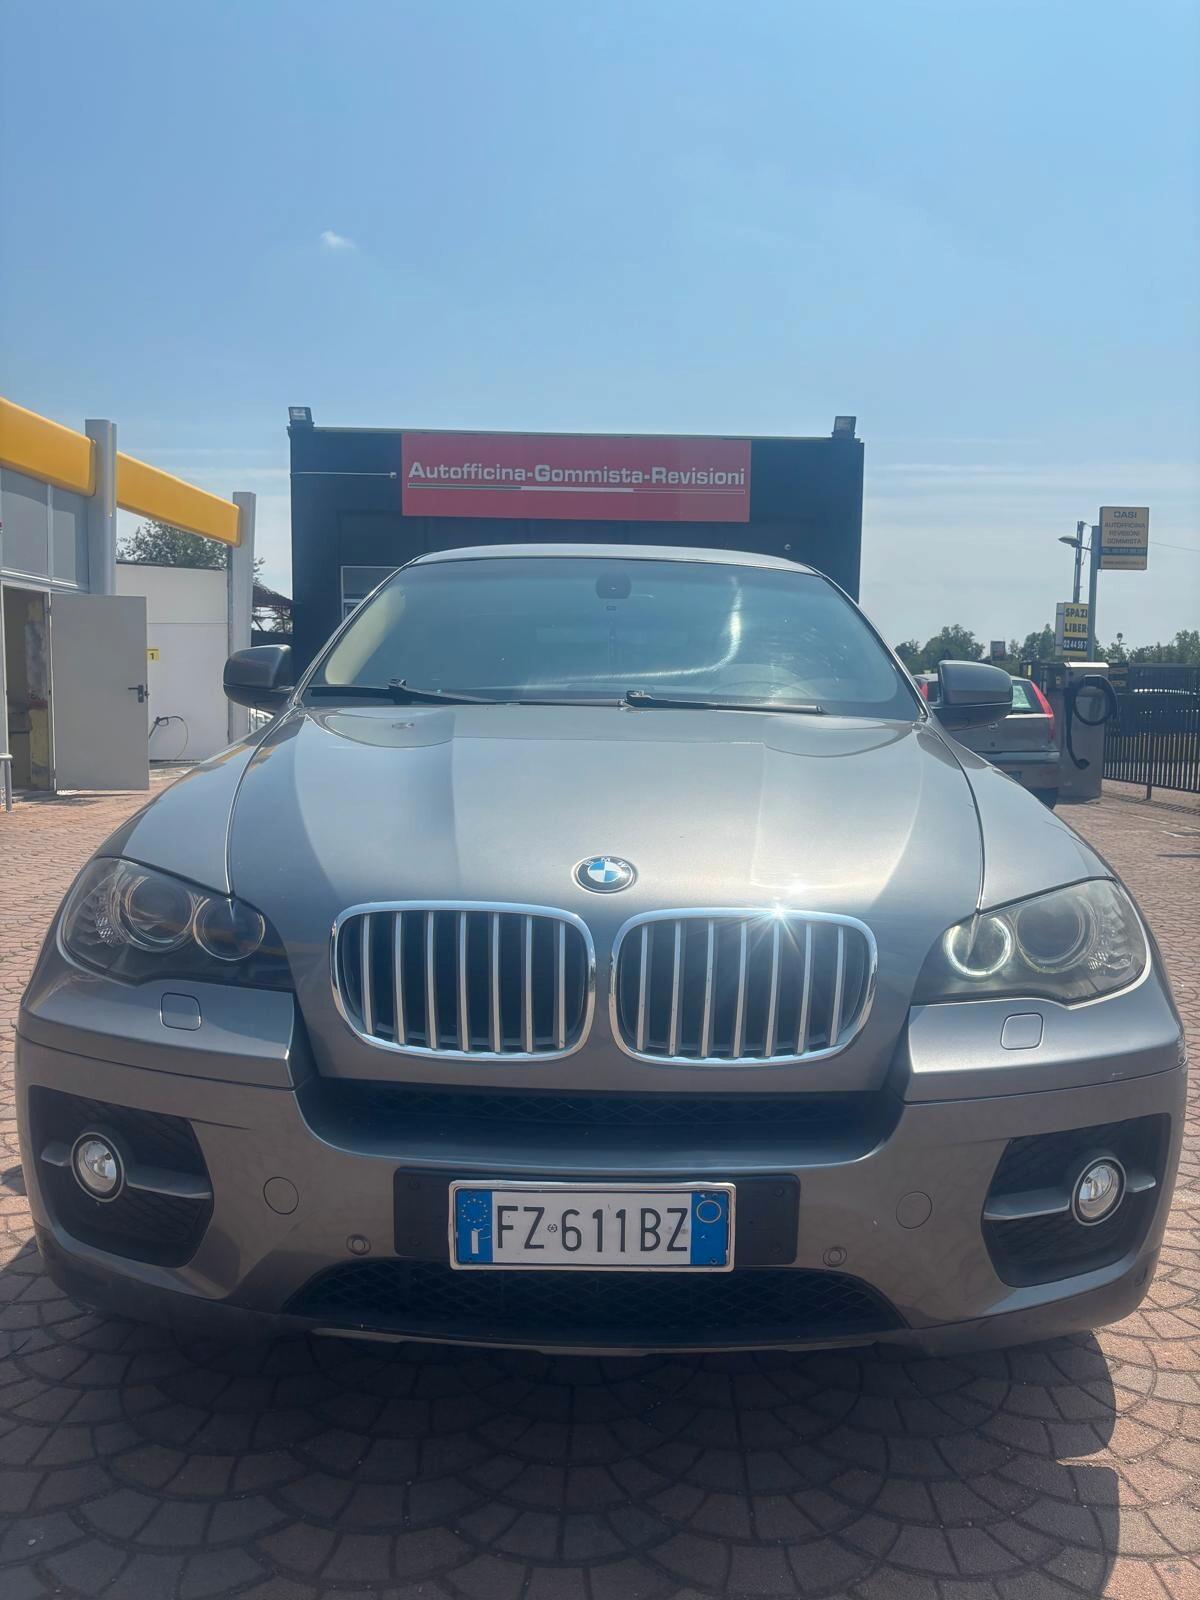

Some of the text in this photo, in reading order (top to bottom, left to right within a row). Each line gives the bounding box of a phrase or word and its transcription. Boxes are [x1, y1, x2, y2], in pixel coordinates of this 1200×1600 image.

[408, 461, 745, 485] Autofficina-Gommista-Revisioni
[1113, 511, 1137, 519] OASI
[1065, 608, 1088, 618] SPAZI
[1064, 623, 1088, 633] LIBER
